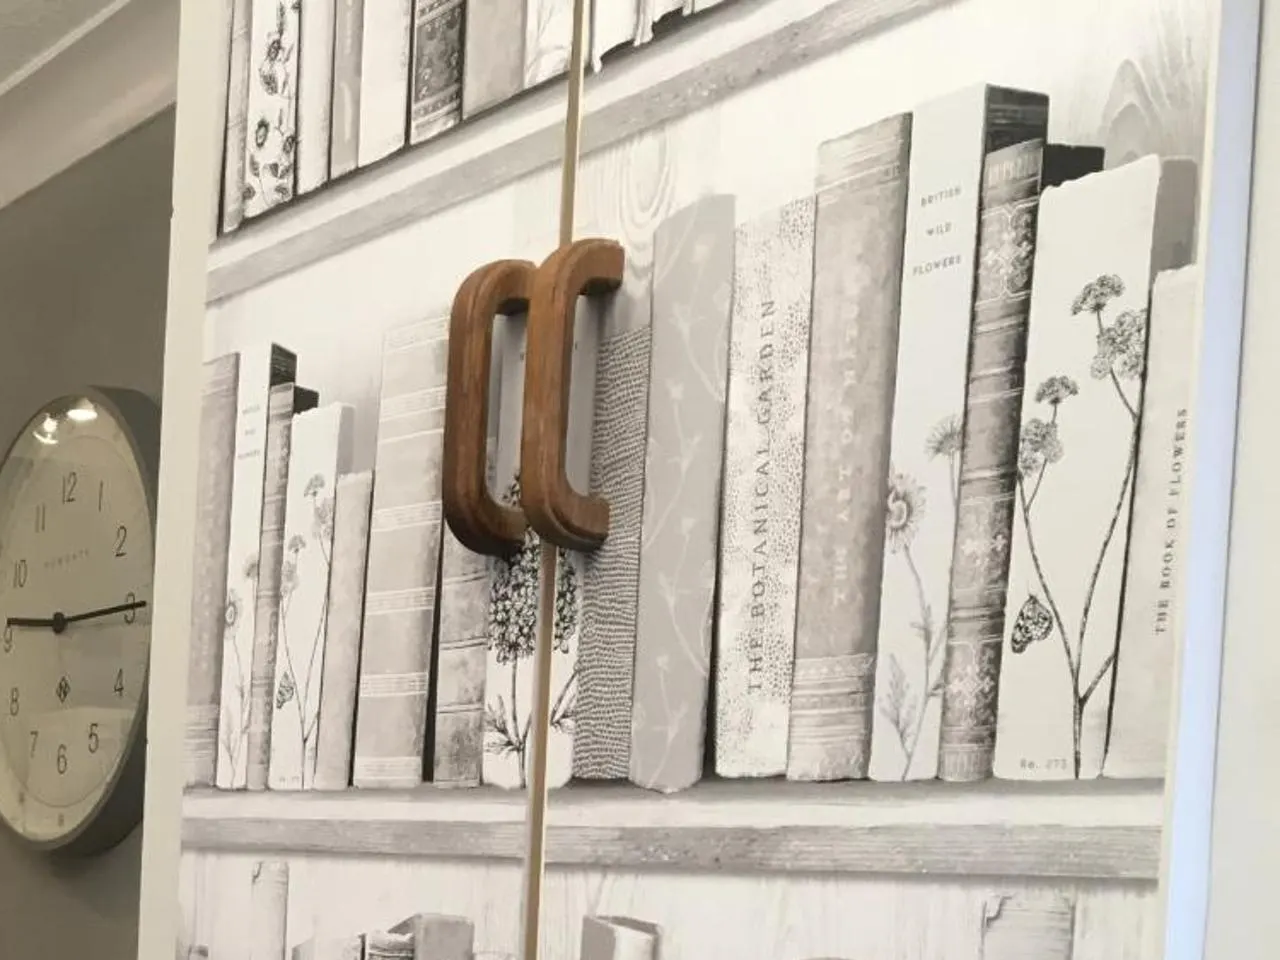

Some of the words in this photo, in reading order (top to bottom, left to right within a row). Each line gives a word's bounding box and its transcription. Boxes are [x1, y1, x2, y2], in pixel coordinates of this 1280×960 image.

[921, 186, 961, 207] BRITISH
[926, 221, 952, 236] WILD
[912, 254, 961, 276] FLOWERS
[757, 300, 775, 424] GARDEN
[1167, 408, 1187, 497] FLOWERS
[61, 471, 78, 505] 12
[98, 479, 104, 513] 1
[34, 503, 46, 534] 11
[751, 440, 771, 618] BOTANICAL
[1166, 507, 1178, 529] OF
[114, 525, 128, 557] 2
[13, 559, 28, 589] 10
[1159, 540, 1176, 589] BOOK
[123, 592, 136, 625] 3
[1153, 599, 1169, 634] THE
[3, 619, 14, 653] 9
[748, 632, 763, 694] THE
[114, 668, 125, 697] 4
[9, 686, 20, 717] 8
[29, 730, 39, 759] 7
[88, 722, 100, 754] 5
[57, 743, 68, 775] 6
